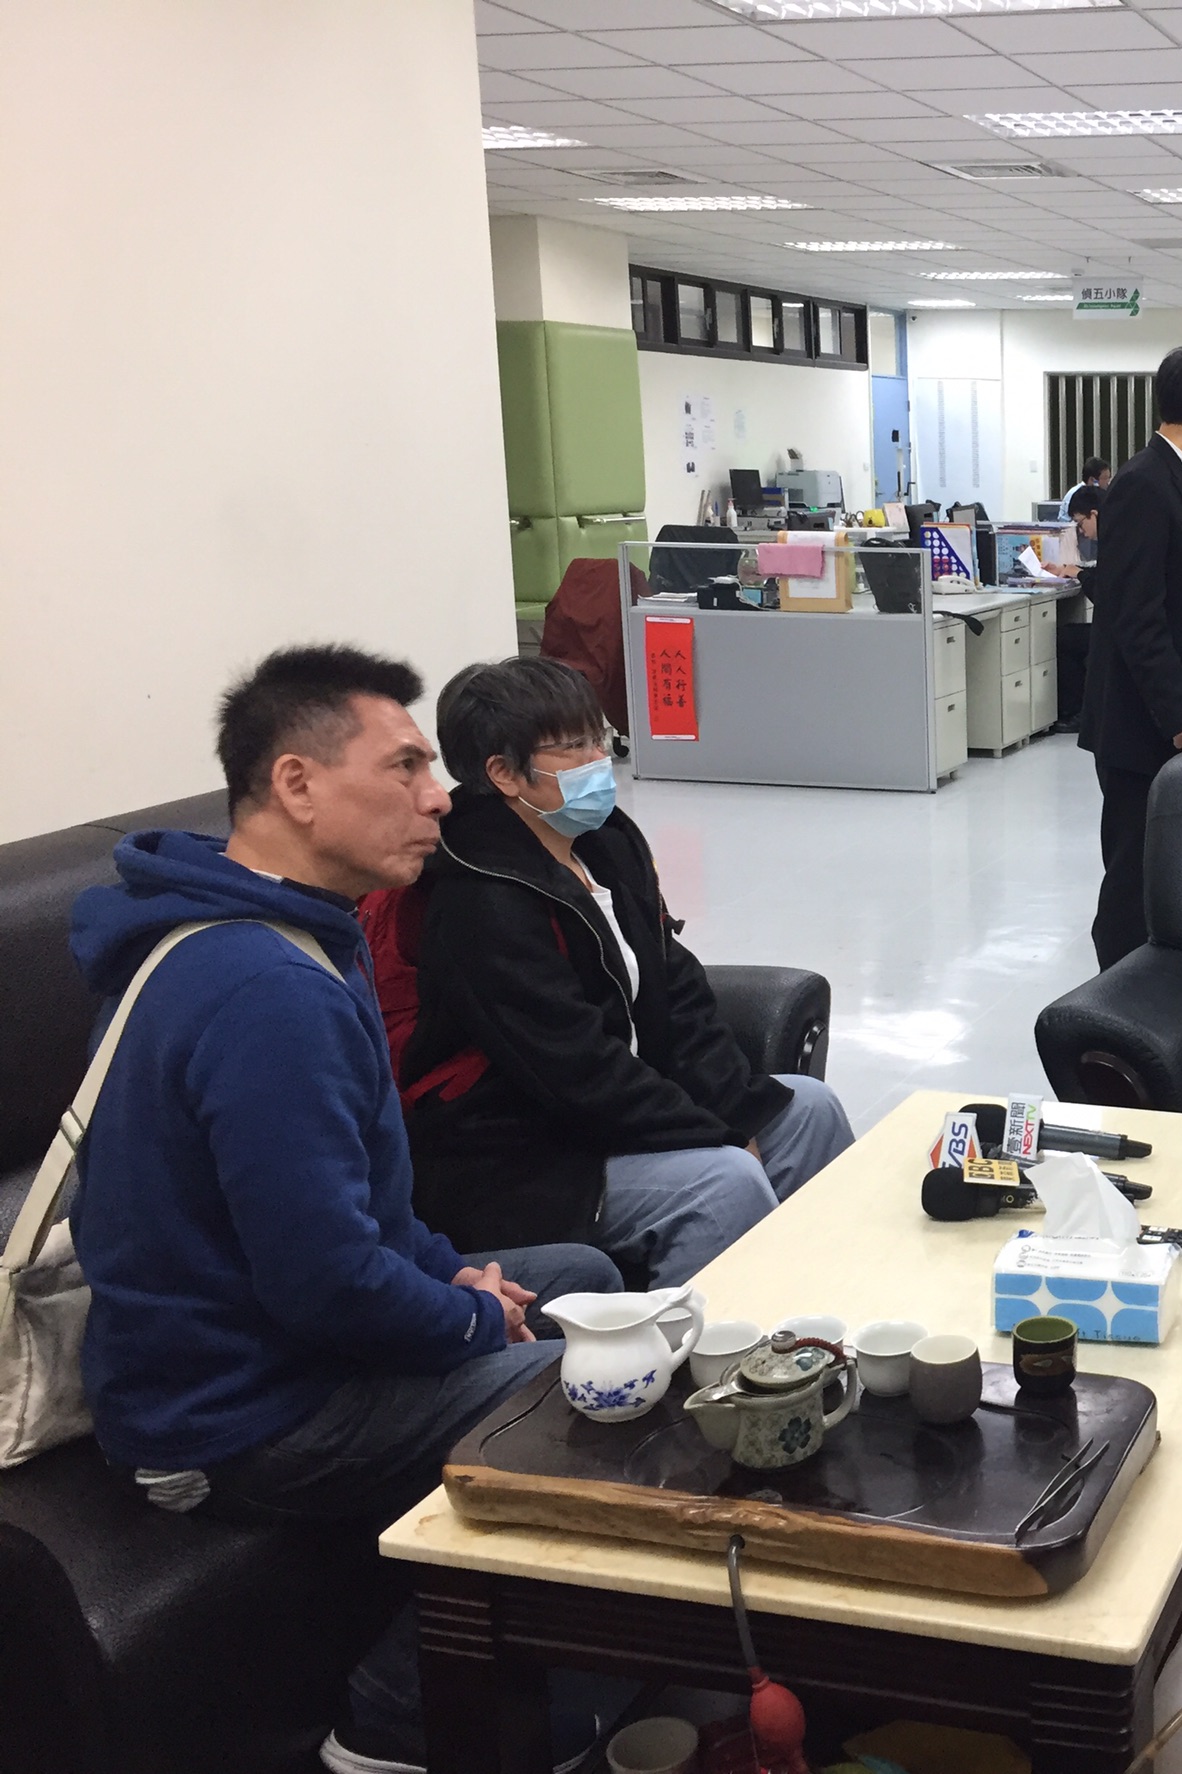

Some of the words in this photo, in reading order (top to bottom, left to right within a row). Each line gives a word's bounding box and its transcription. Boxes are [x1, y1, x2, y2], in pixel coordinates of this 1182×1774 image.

[1081, 288, 1128, 300] 偵五小隊
[675, 649, 687, 708] 人人行善
[1006, 1101, 1026, 1154] 壹新聞
[968, 1158, 994, 1180] EBC
